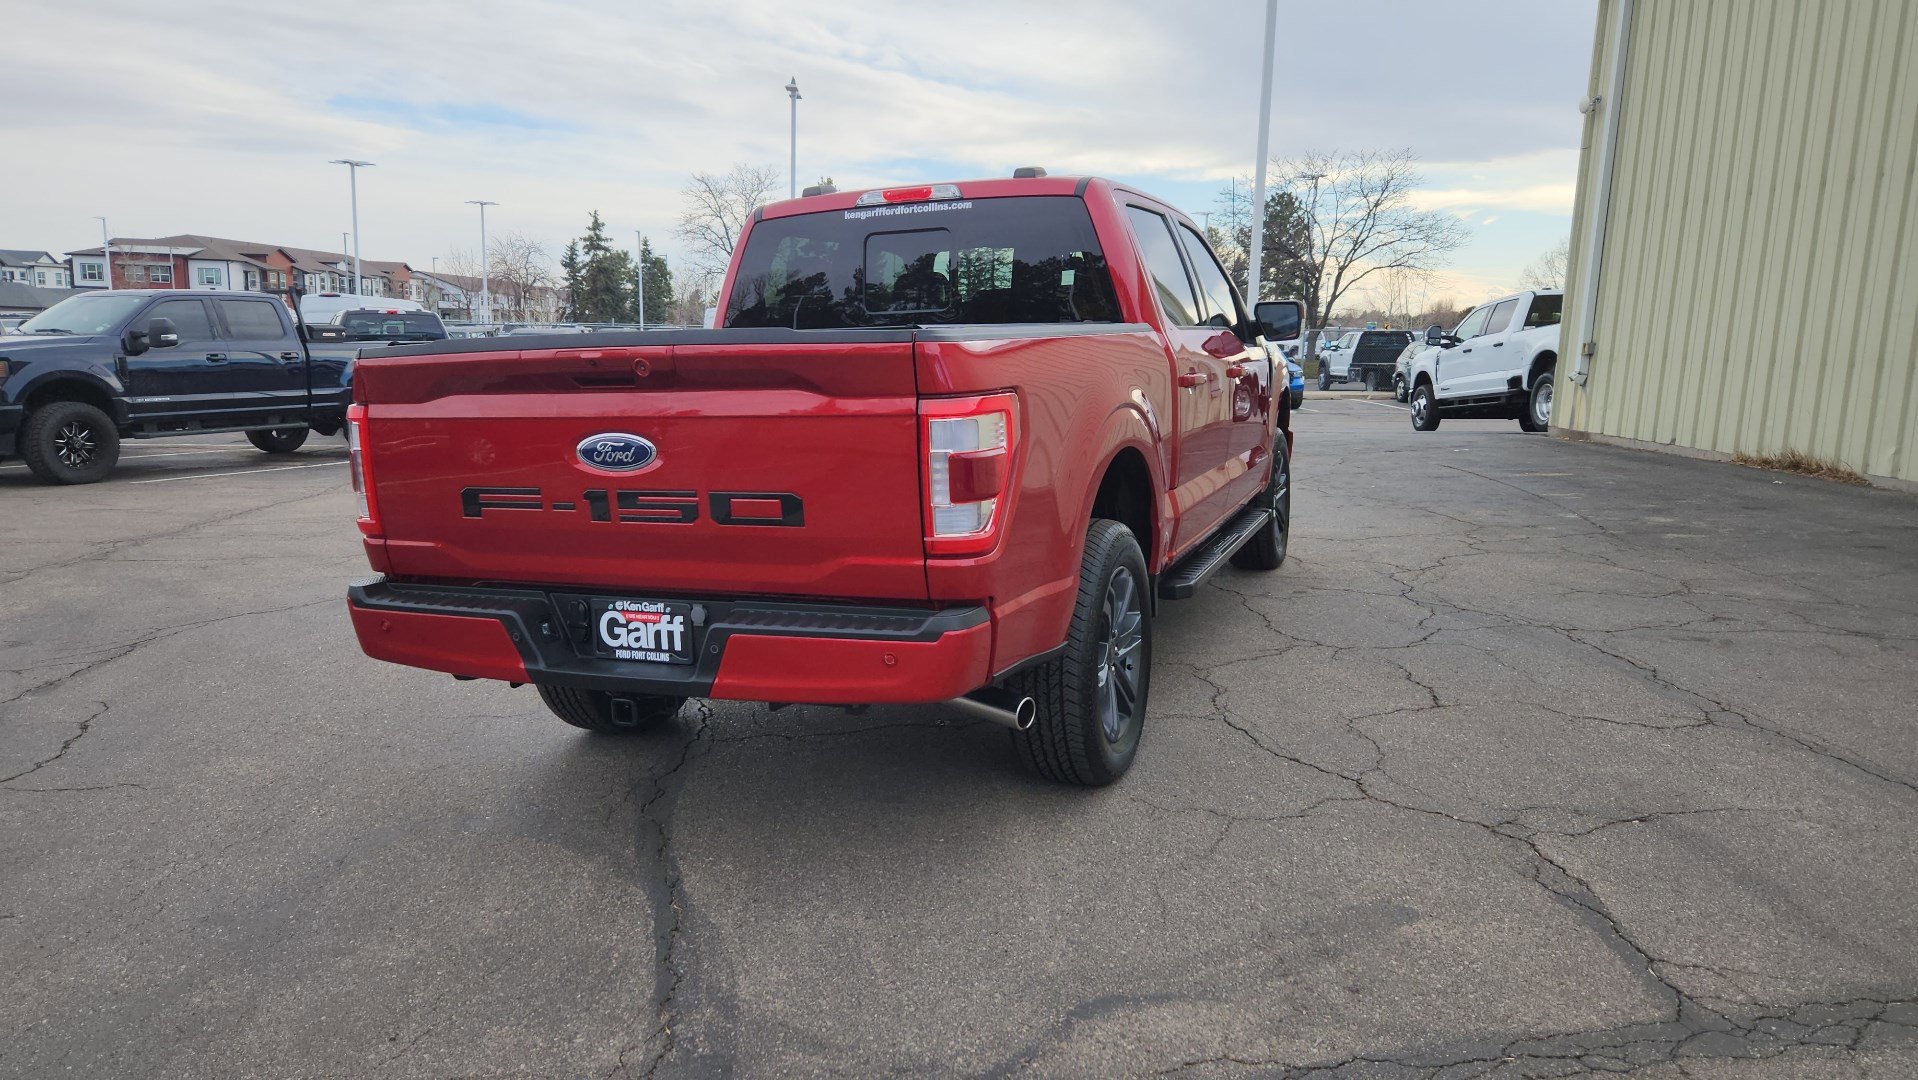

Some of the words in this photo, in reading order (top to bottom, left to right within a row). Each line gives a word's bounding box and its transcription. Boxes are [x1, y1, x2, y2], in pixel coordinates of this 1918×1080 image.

[844, 201, 972, 219] kengarfffordfortcollins.com
[592, 441, 636, 463] Ford
[460, 487, 806, 528] F-150
[623, 601, 641, 611] Ken
[642, 602, 664, 612] Garff
[599, 610, 684, 651] Garff
[616, 650, 631, 659] FORD
[631, 650, 646, 660] FORT
[646, 652, 669, 662] COLLINS
